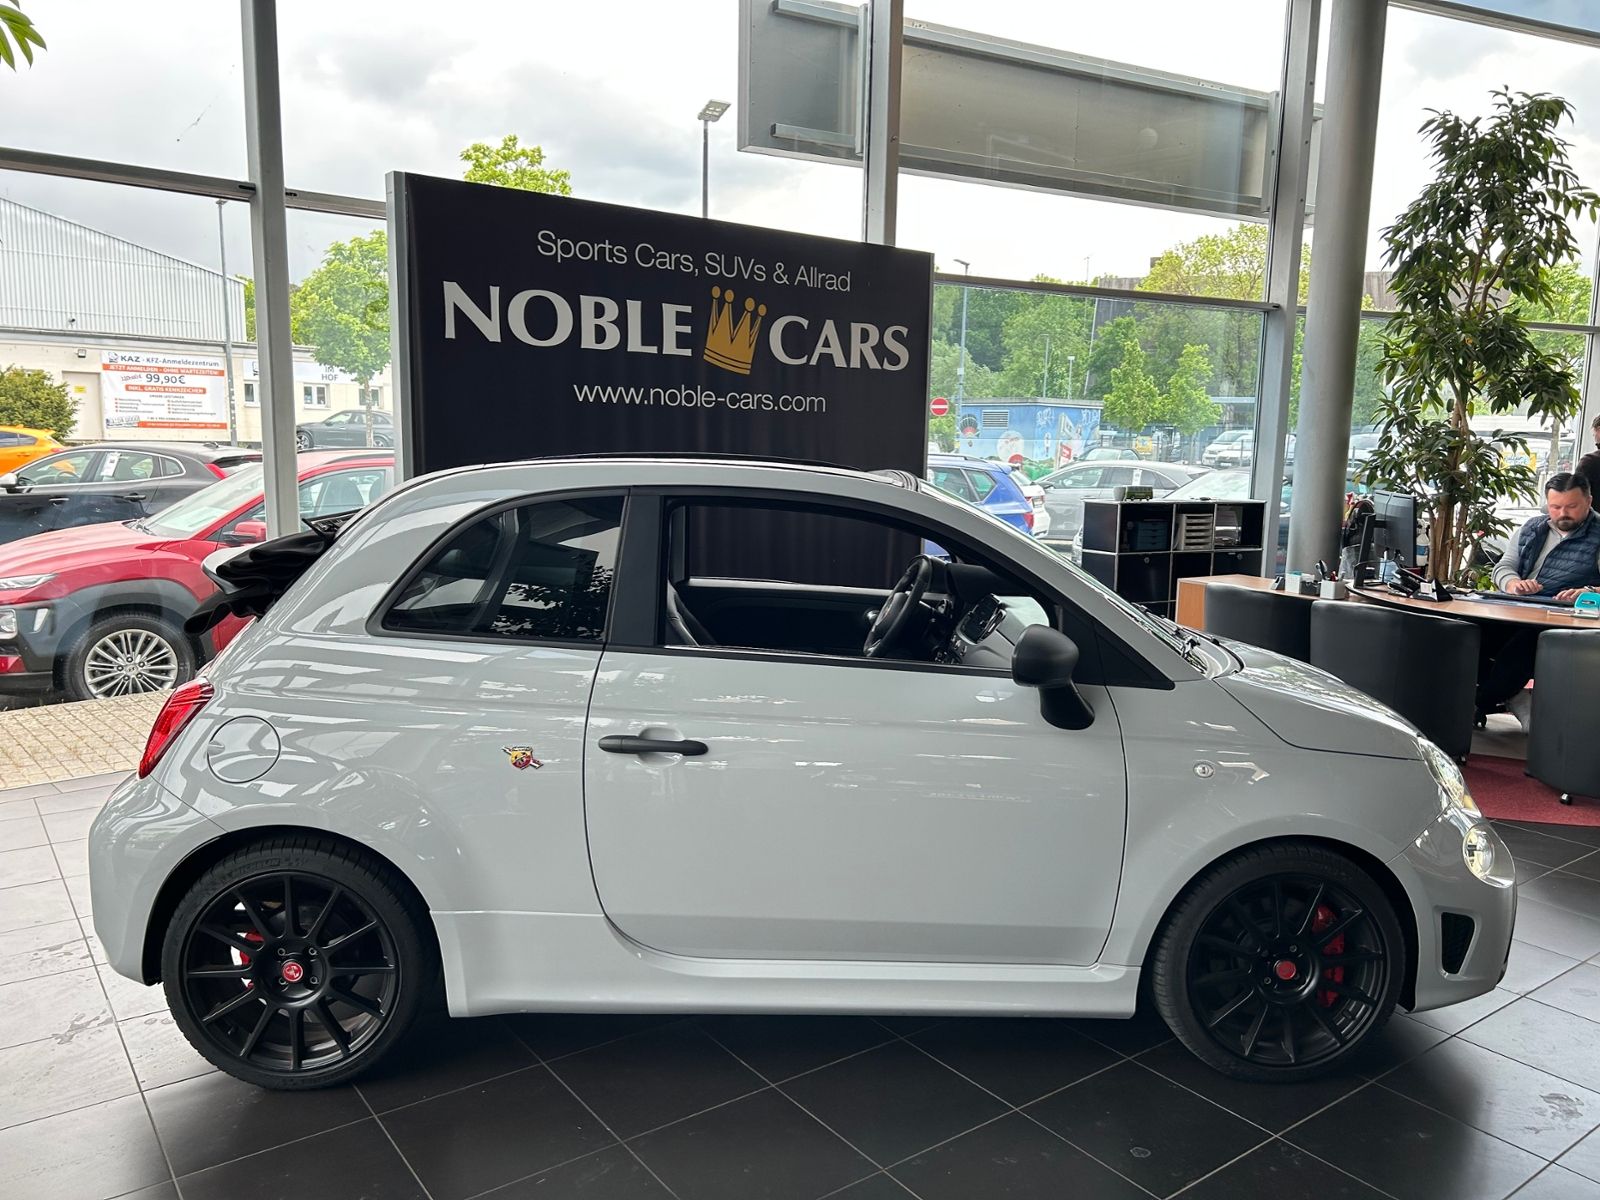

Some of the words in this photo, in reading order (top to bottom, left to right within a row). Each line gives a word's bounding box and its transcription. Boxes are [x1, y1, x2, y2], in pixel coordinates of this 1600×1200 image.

[537, 230, 627, 265] Sports
[635, 243, 699, 277] Cars,
[704, 252, 767, 282] SUVs
[772, 262, 790, 285] &
[794, 265, 851, 292] Allrad
[443, 280, 692, 357] NOBLE
[769, 315, 910, 371] CARS
[120, 355, 141, 363] KAZ
[146, 357, 220, 367] KFZ-Anmeldezentrum
[145, 373, 186, 385] 99,90€
[321, 373, 339, 381] HOF
[573, 384, 826, 413] www.noble-cars.com
